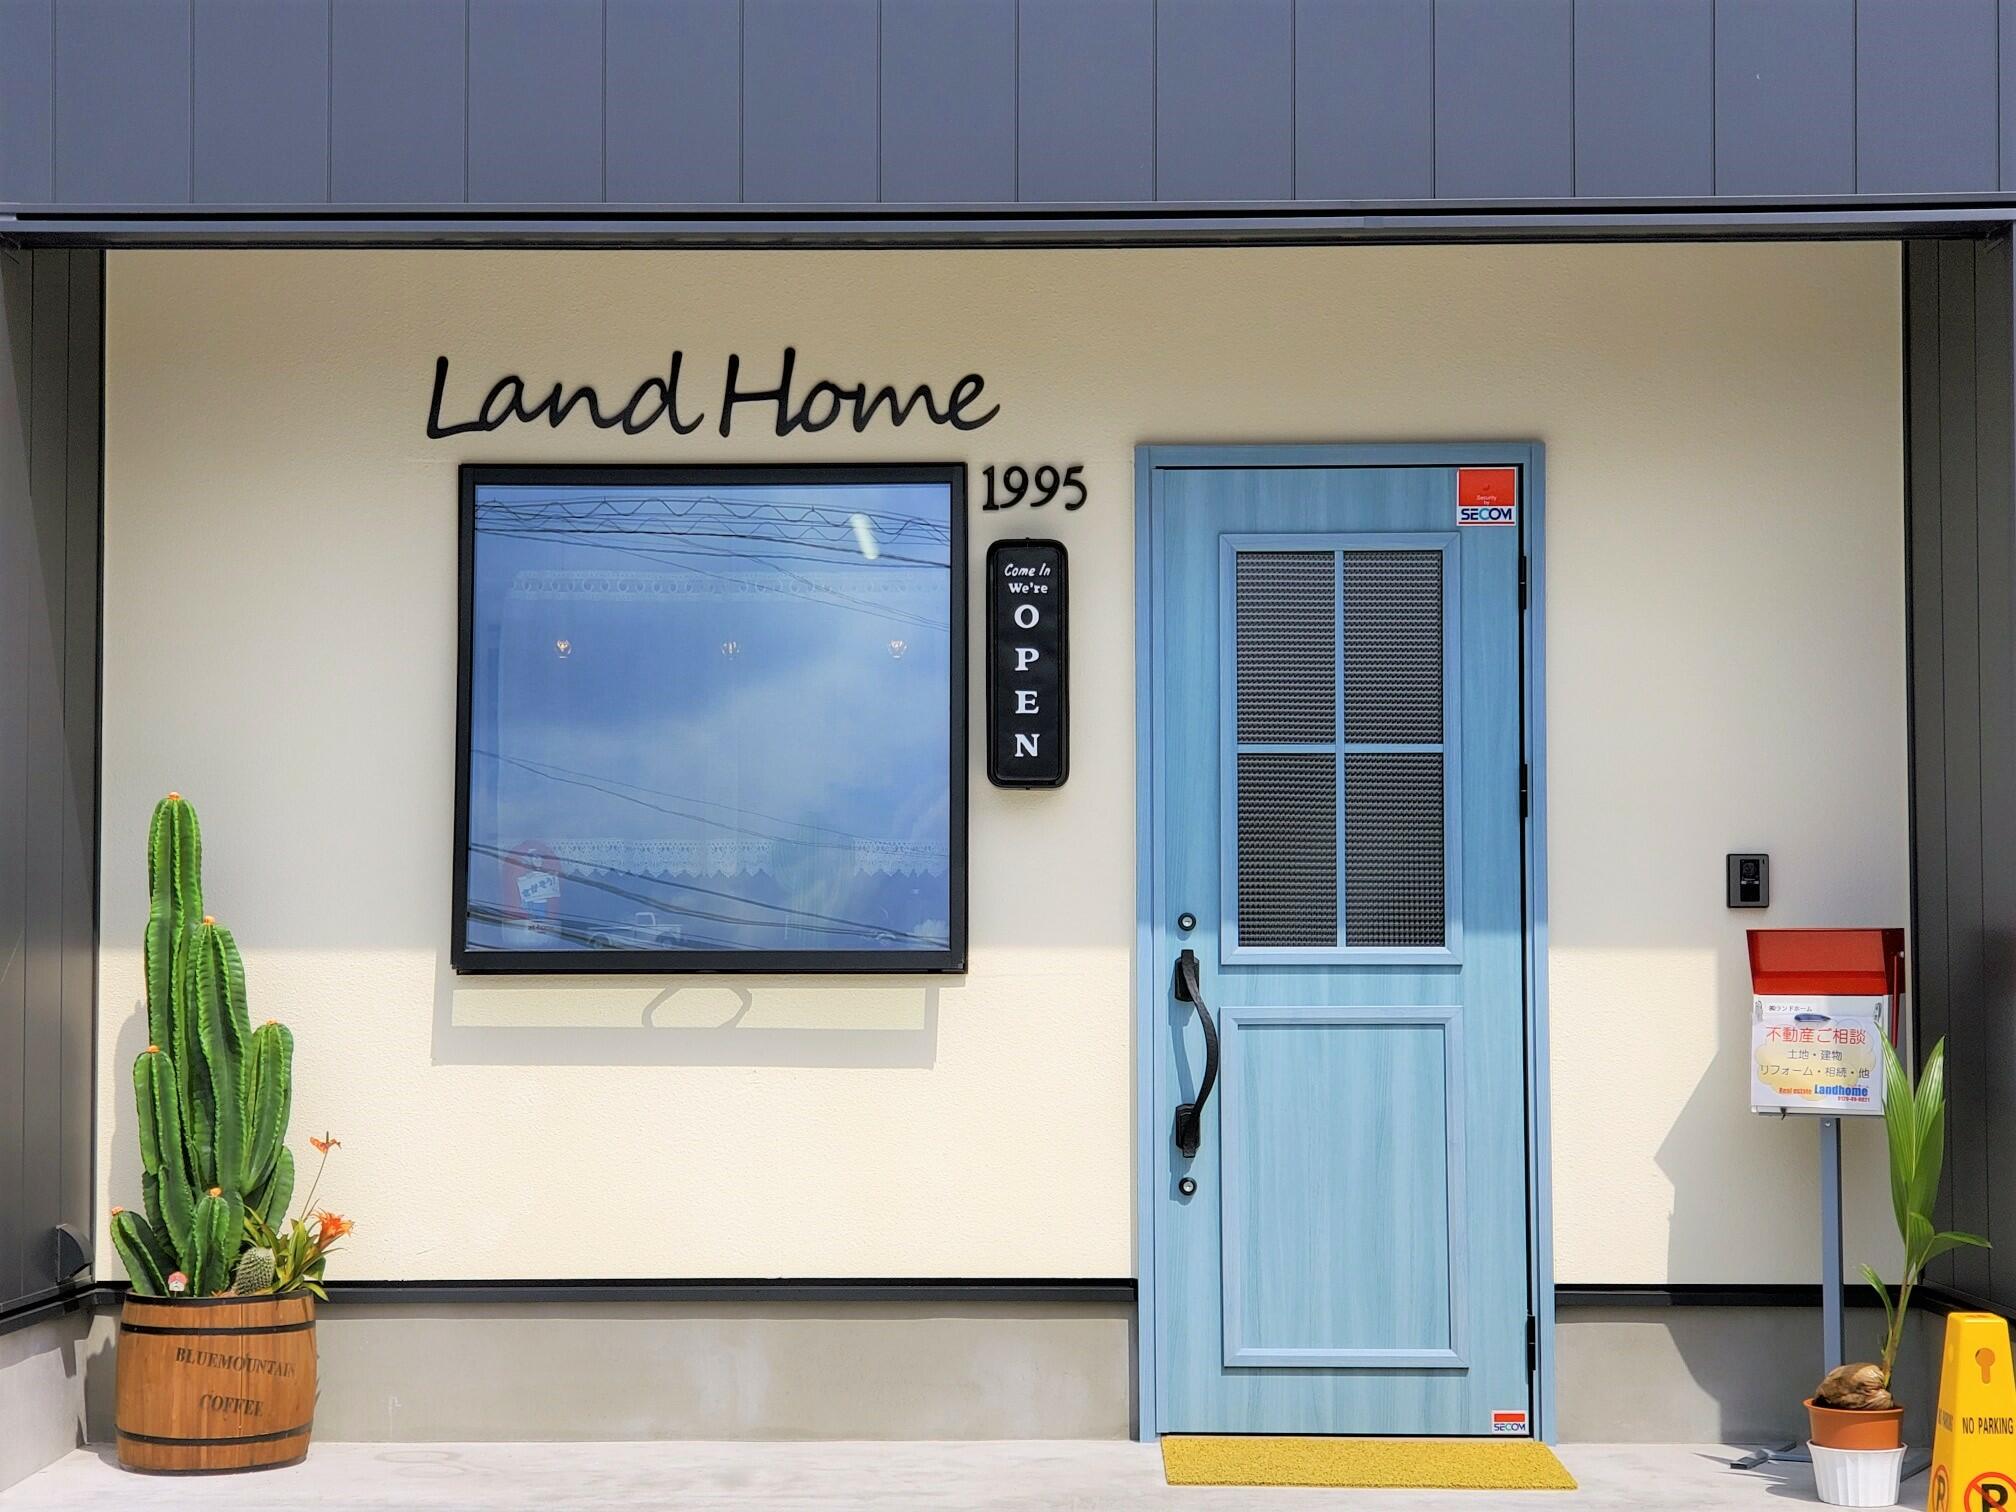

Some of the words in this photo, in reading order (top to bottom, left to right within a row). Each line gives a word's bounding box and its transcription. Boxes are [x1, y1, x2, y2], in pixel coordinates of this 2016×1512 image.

[426, 350, 705, 439] Land
[719, 346, 1001, 439] Home
[982, 465, 1088, 511] 1995
[1460, 508, 1512, 520] SECOM
[1004, 563, 1035, 577] Come
[1039, 562, 1051, 576] In
[1008, 582, 1049, 594] We're
[1014, 604, 1040, 758] OPEN
[1766, 1026, 1866, 1045] 不動産ご相談
[1814, 1084, 1868, 1097] Landhome
[175, 1347, 297, 1378] BLUEMOUNTAIN
[200, 1393, 264, 1417] COFFEE
[1494, 1423, 1526, 1431] SECOM
[1962, 1417, 1975, 1435] NO
[1978, 1417, 2014, 1435] PARKING
